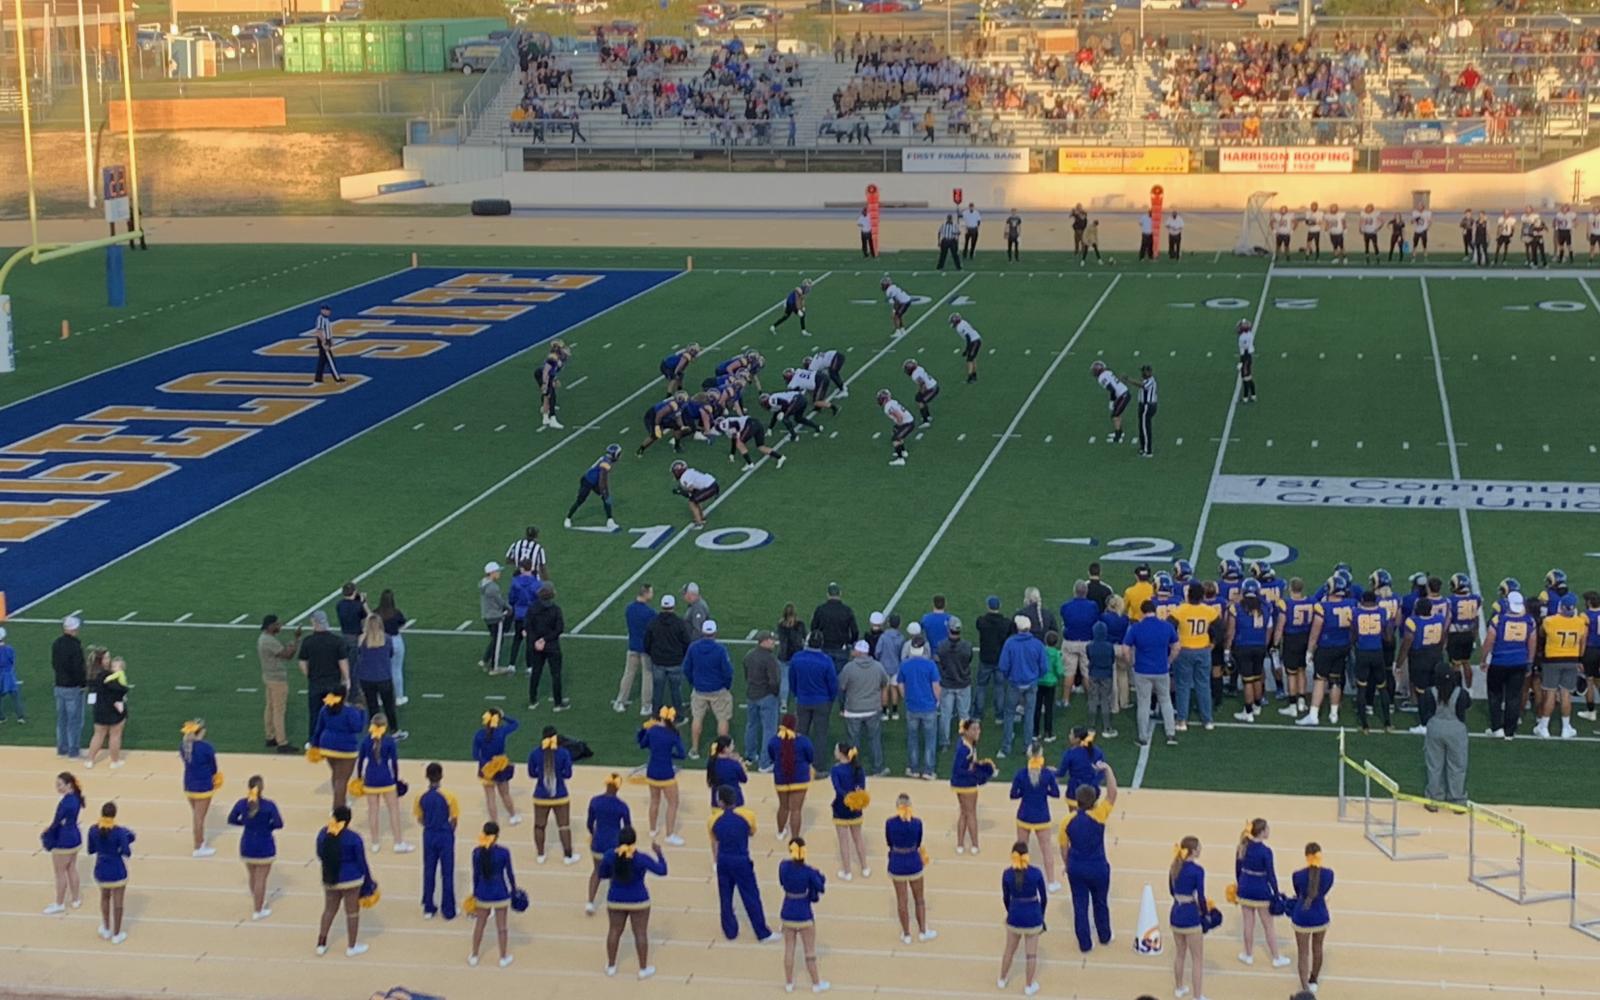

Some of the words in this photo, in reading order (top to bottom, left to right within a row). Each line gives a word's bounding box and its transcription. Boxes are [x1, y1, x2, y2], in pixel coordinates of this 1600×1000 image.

[906, 151, 935, 161] FIRST
[938, 151, 991, 161] FINANCIAL
[994, 151, 1022, 161] BANK
[1223, 152, 1289, 162] HARRISON
[1293, 152, 1351, 162] ROOFING
[252, 273, 605, 359] STATE
[1249, 477, 1324, 489] 1st
[1276, 491, 1447, 506] Credit
[628, 524, 775, 551] 10
[1100, 537, 1299, 564] 20
[1186, 618, 1206, 635] 70
[1358, 613, 1381, 636] 85
[1556, 631, 1578, 648] 77
